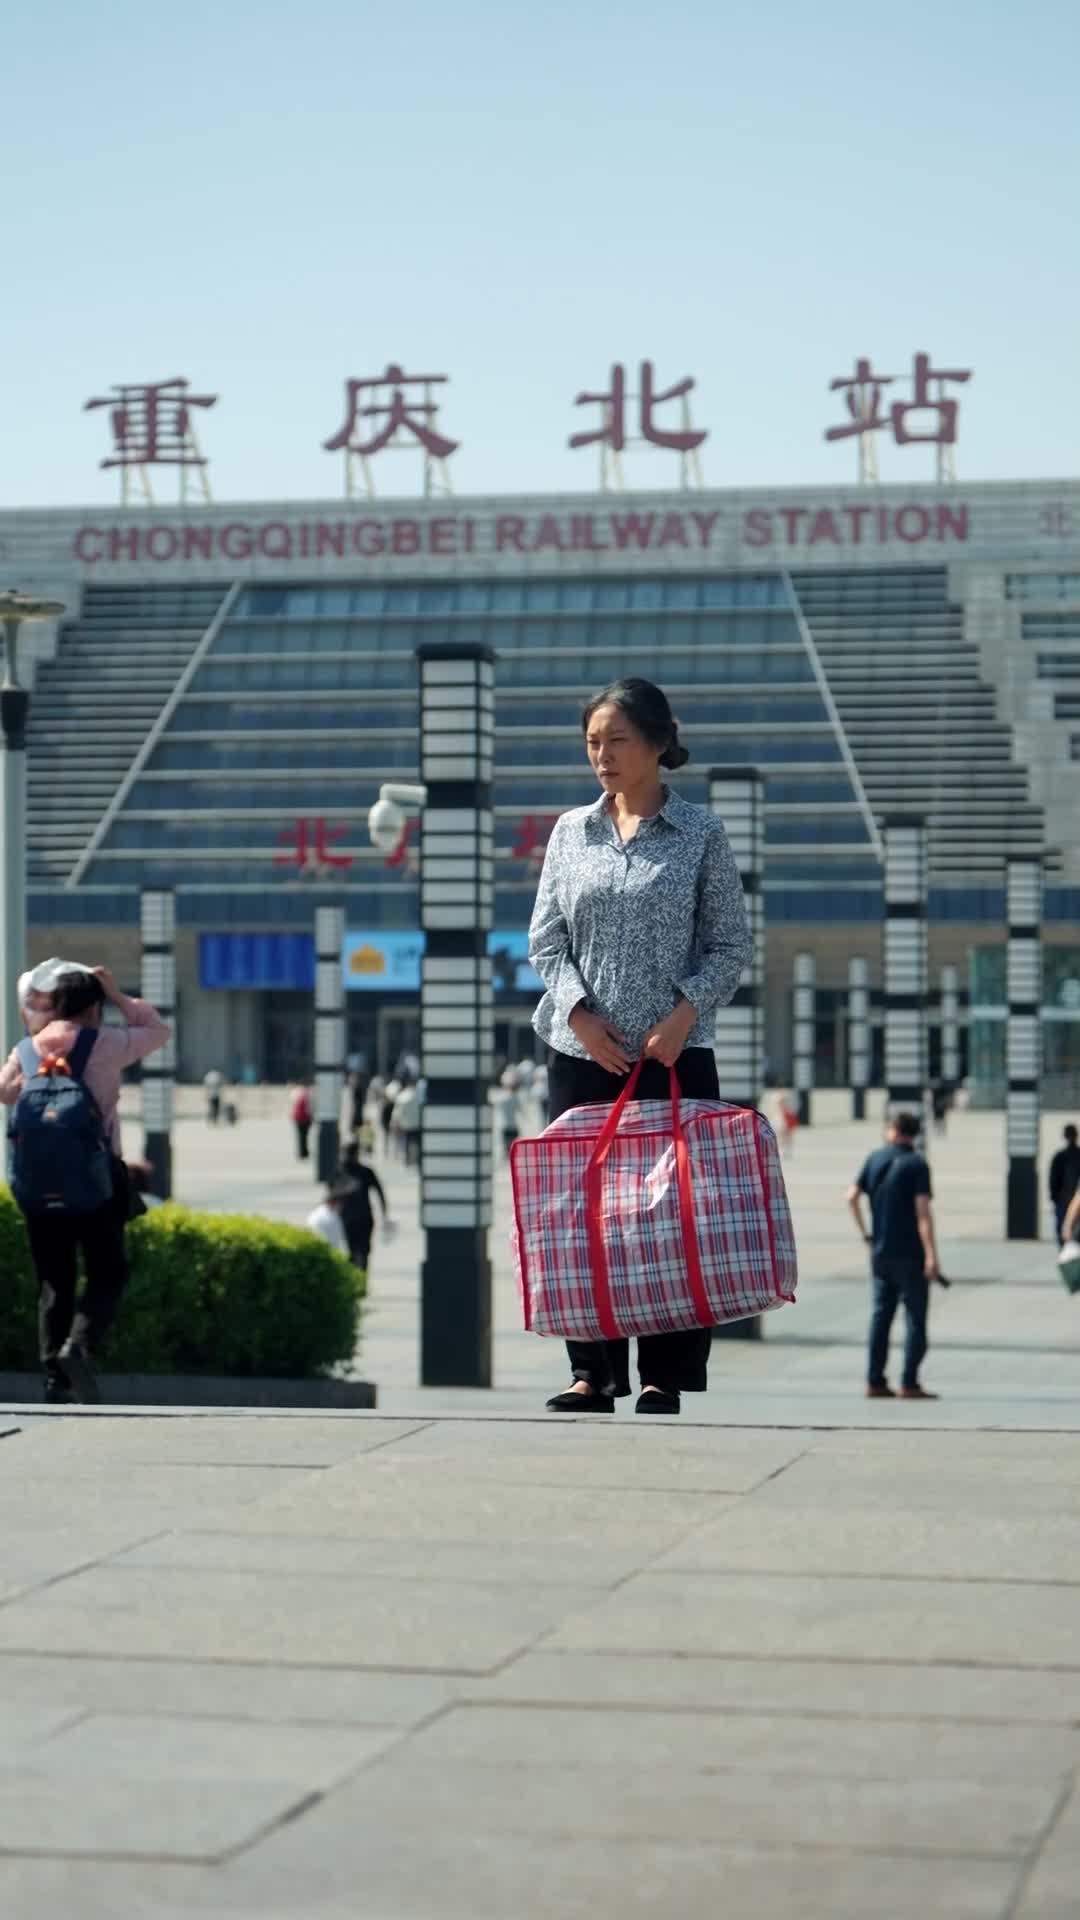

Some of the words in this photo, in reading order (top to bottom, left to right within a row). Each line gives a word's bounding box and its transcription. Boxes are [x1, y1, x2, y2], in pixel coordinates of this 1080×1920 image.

[84, 352, 972, 468] 重庆北站
[74, 518, 474, 562] CHONGQINGBEI
[495, 510, 717, 552] RAILWAY
[743, 503, 969, 546] STATION
